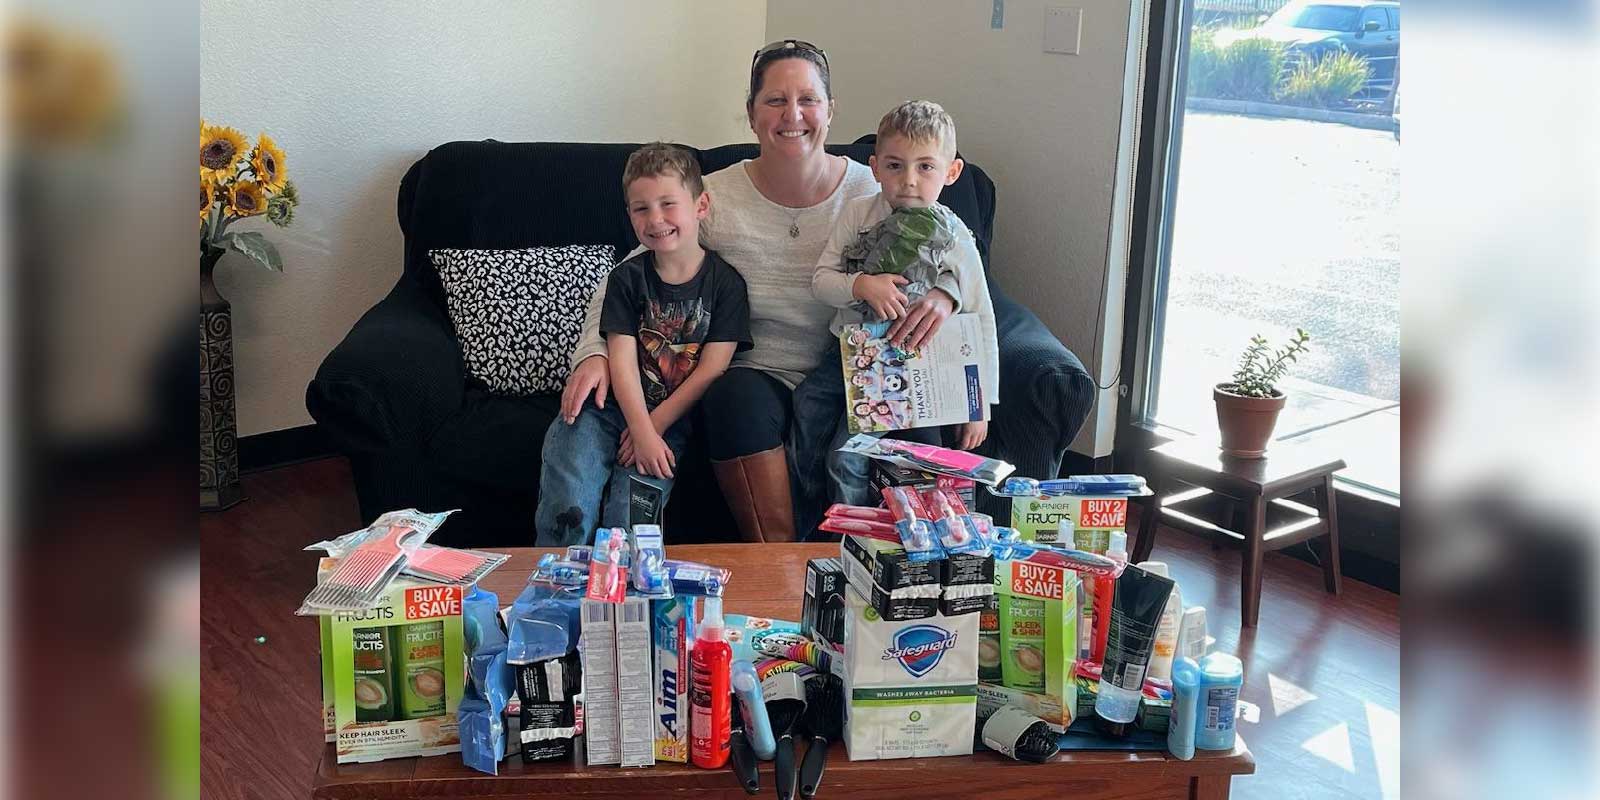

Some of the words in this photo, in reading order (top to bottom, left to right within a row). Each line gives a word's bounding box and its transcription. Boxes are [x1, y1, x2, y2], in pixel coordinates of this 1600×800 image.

[911, 369, 921, 389] YOU
[915, 390, 926, 420] THANK
[1088, 500, 1112, 513] BUY
[1114, 501, 1122, 512] 2
[1081, 515, 1091, 526] &
[1091, 513, 1125, 527] SAVE
[1019, 564, 1046, 580] BUY
[1047, 570, 1057, 583] 2
[413, 588, 443, 603] BUY
[444, 587, 454, 601] 2
[1013, 578, 1023, 592] &
[1024, 578, 1062, 599] SAVE
[407, 605, 418, 619] &
[419, 600, 460, 618] SAVE
[353, 640, 384, 650] UCTIS
[881, 630, 958, 661] Safeguard
[658, 669, 677, 741] Aim
[360, 730, 381, 738] HAIR
[381, 728, 406, 736] SLEEK
